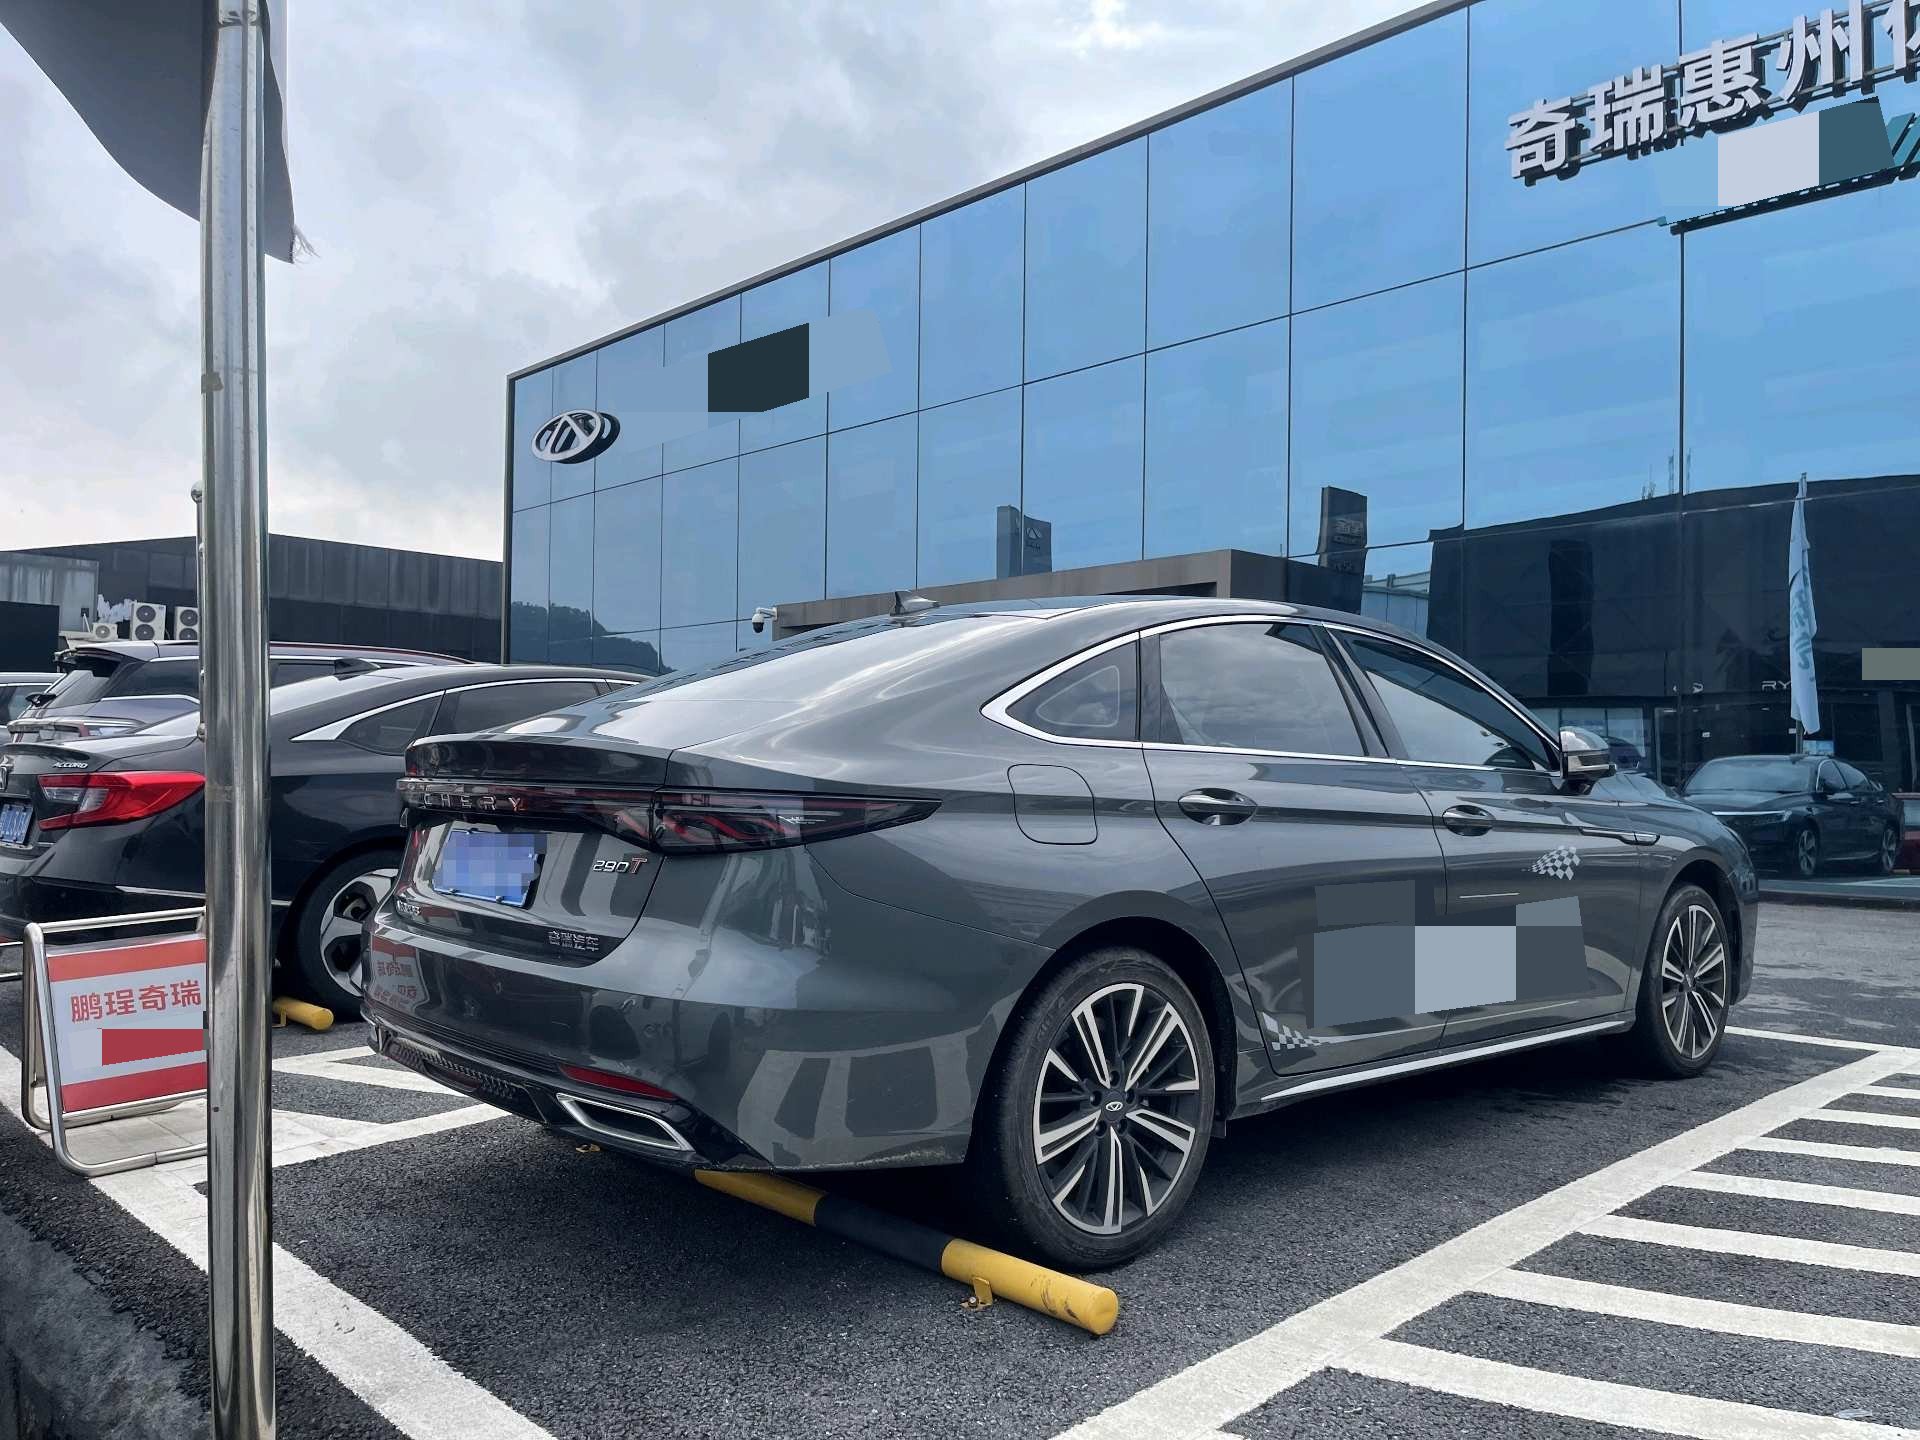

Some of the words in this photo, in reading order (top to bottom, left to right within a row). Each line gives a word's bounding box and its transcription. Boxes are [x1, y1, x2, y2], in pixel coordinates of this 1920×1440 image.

[53, 761, 89, 769] ACCORD
[424, 793, 521, 812] CHERY
[592, 857, 648, 874] 290T
[547, 930, 599, 952] 奇瑞汽车
